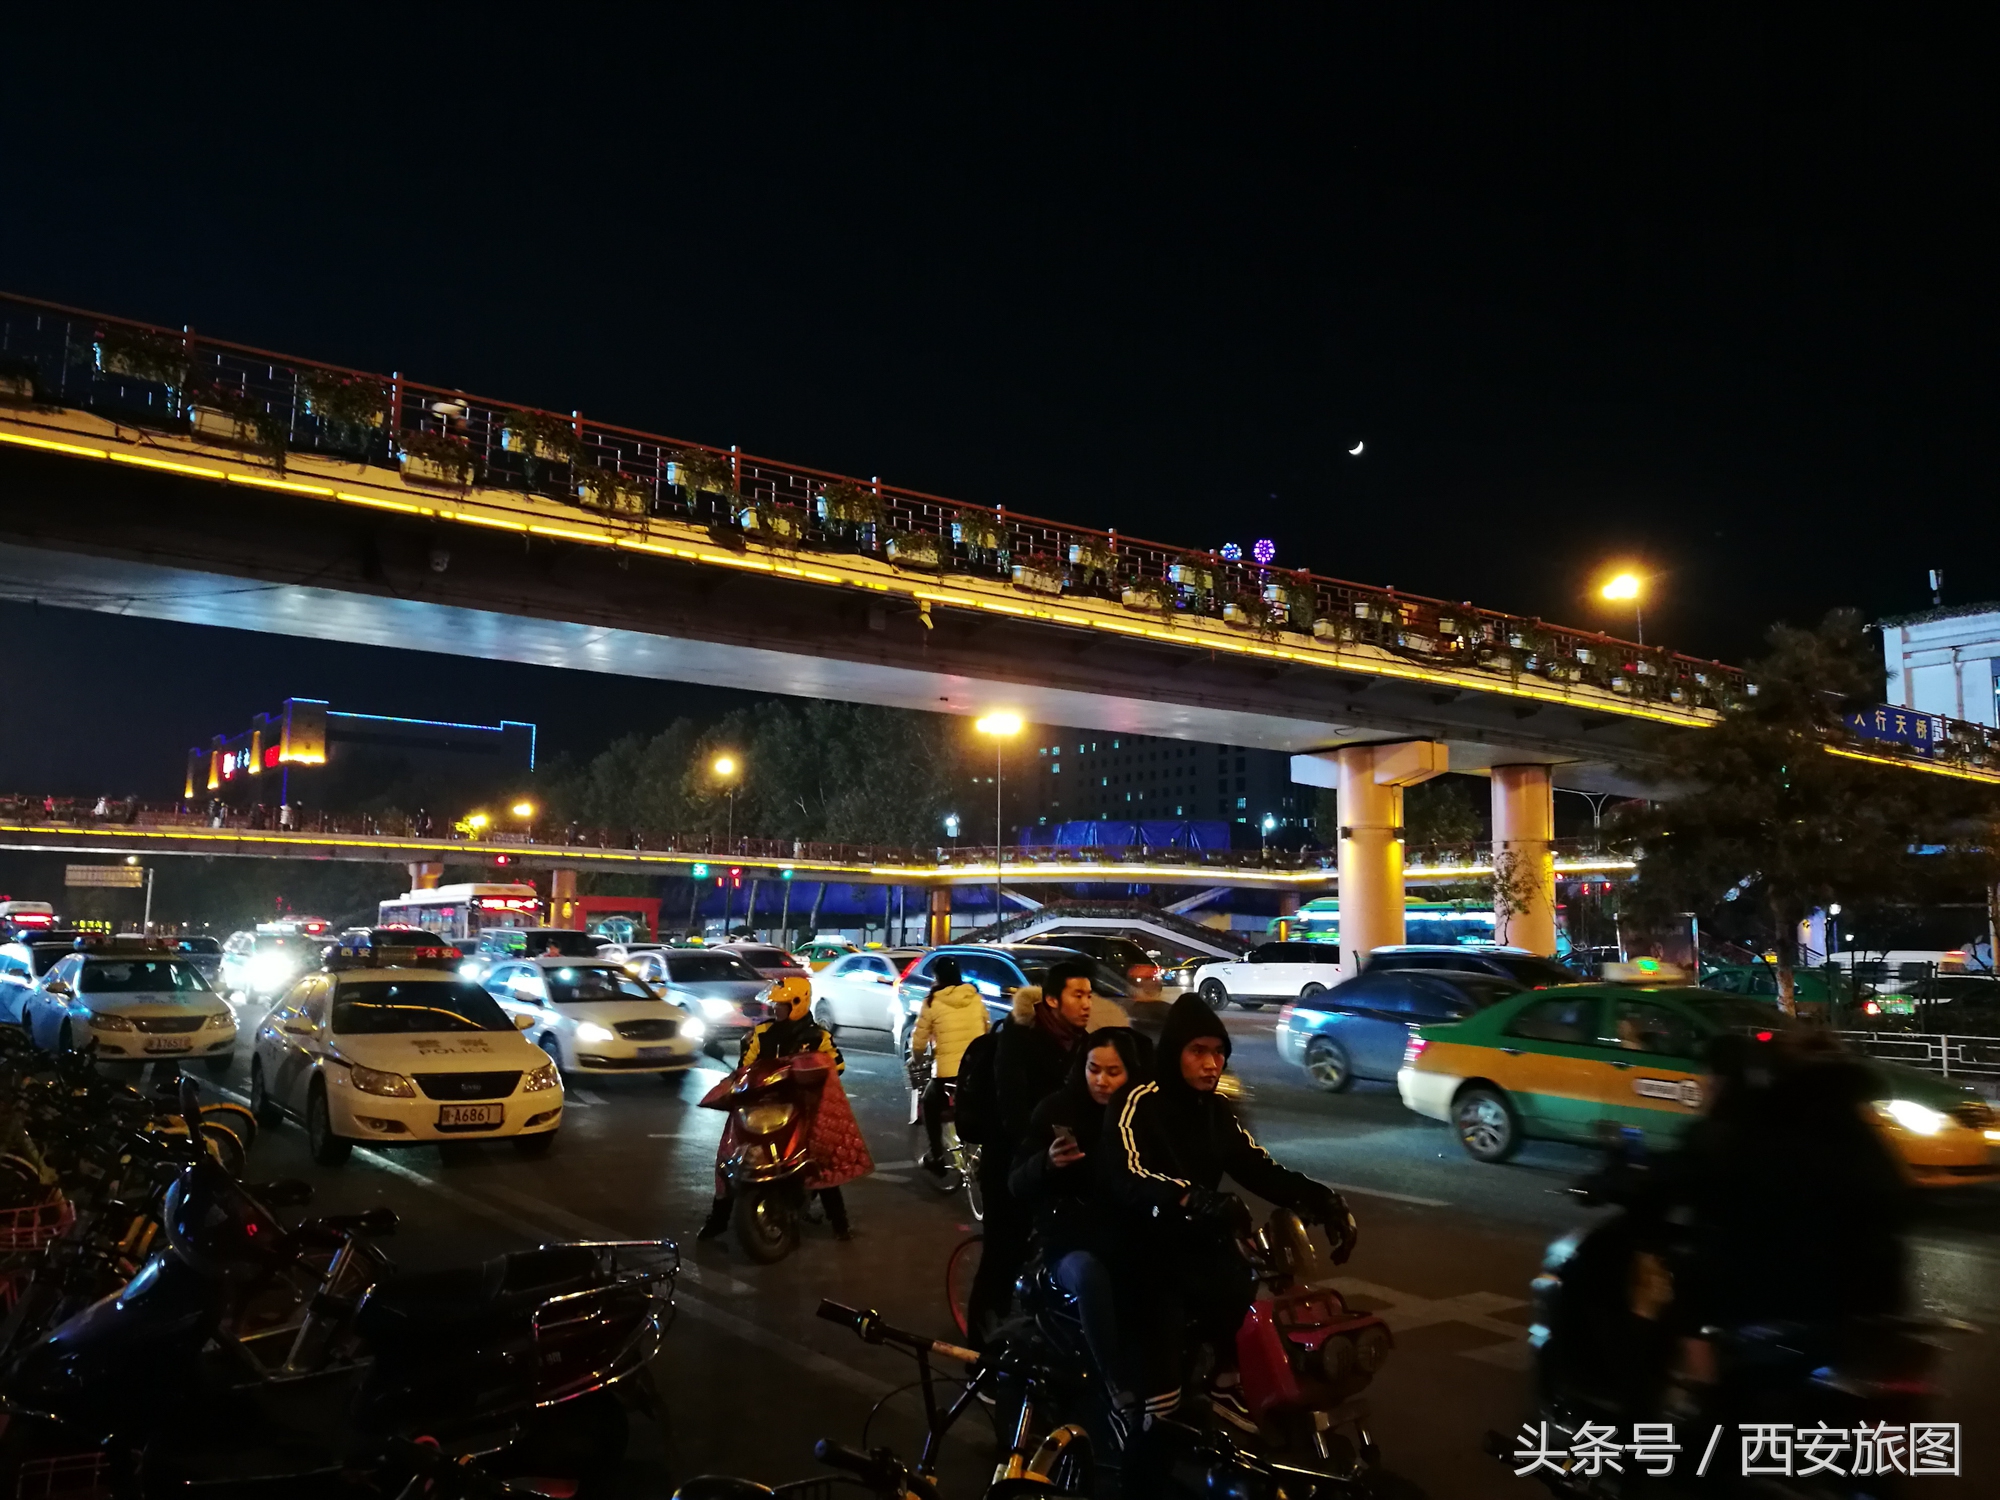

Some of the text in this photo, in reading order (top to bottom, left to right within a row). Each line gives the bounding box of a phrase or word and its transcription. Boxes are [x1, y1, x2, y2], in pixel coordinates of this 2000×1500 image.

[1854, 710, 1928, 740] 人行天桥
[425, 948, 454, 959] 公安
[418, 1047, 495, 1055] POLICE
